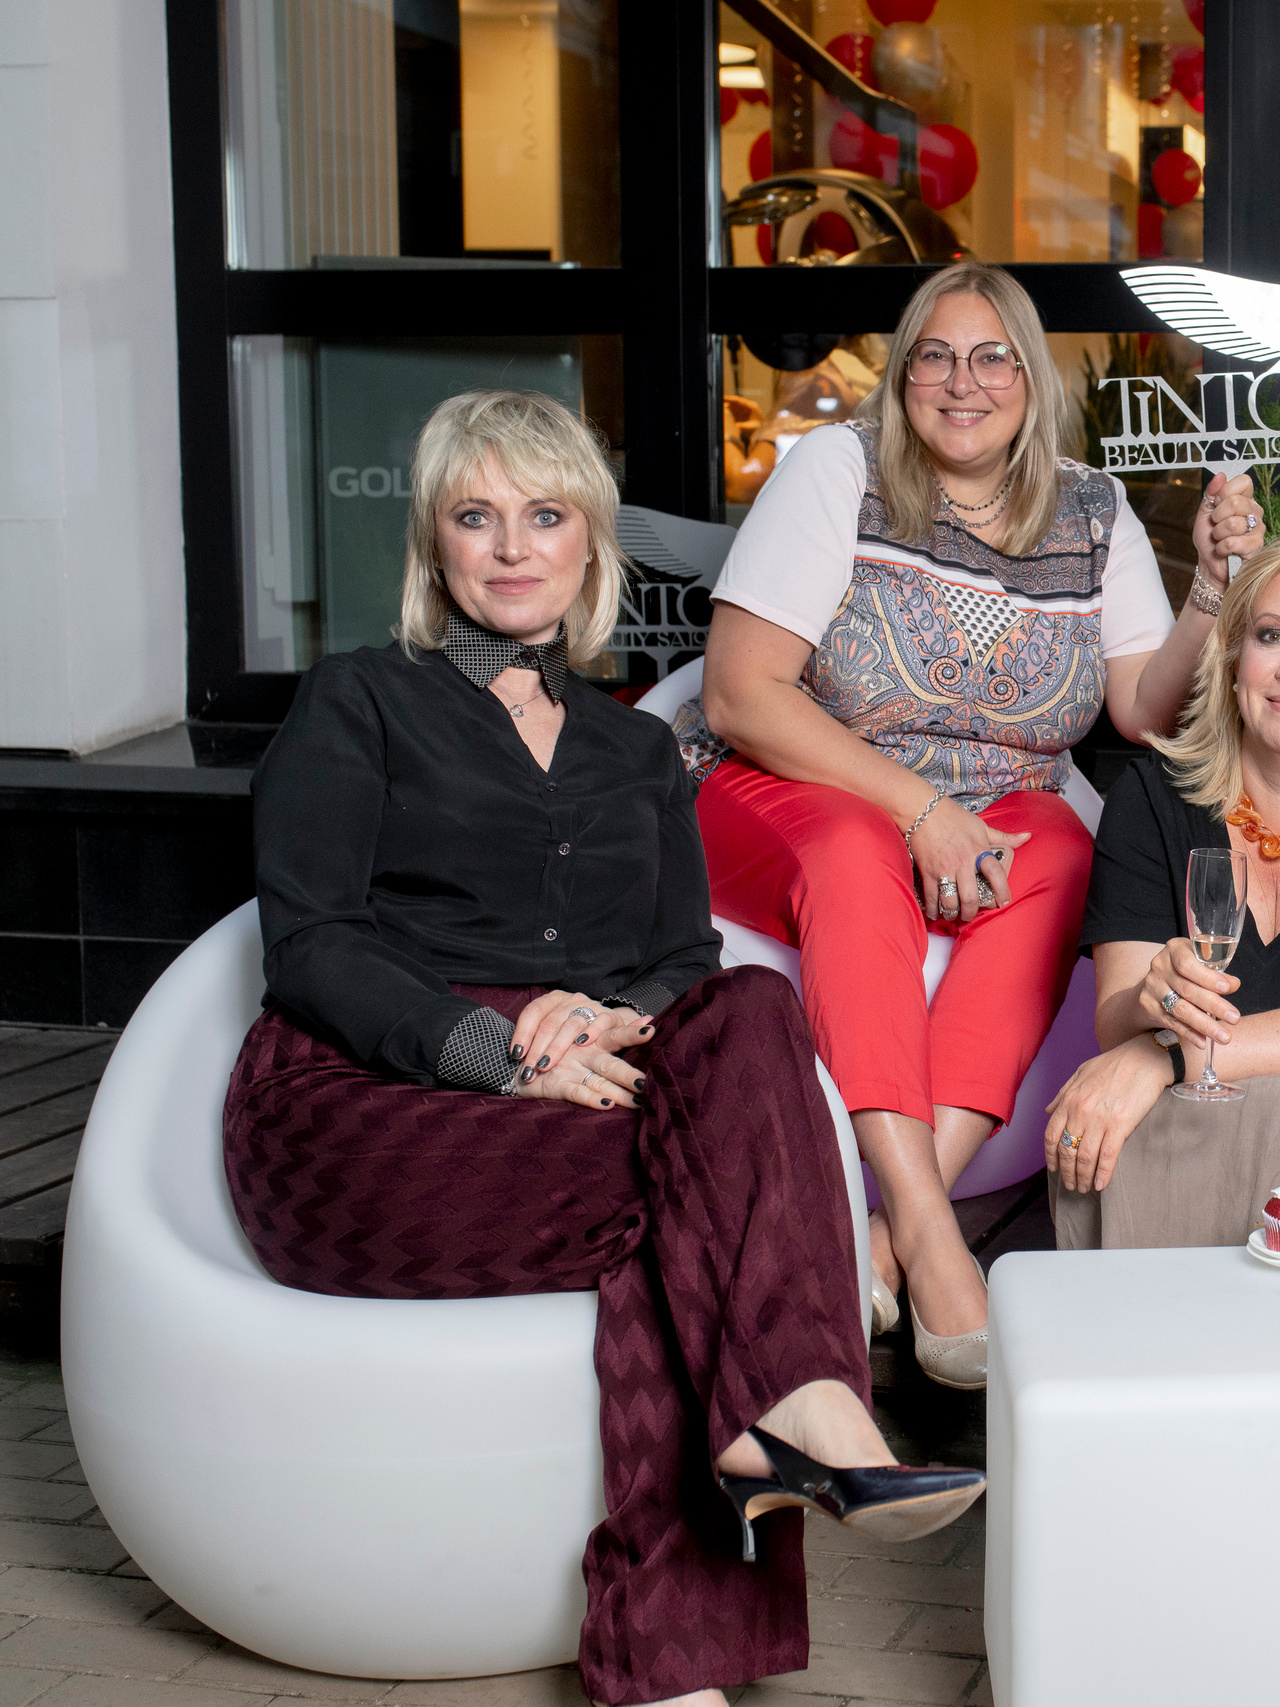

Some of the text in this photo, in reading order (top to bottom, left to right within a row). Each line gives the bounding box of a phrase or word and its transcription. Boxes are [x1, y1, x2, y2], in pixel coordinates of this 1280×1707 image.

[1103, 439, 1214, 469] BEAUTY
[329, 466, 416, 498] GOL
[618, 582, 714, 628] NTO
[656, 630, 709, 649] SALO
